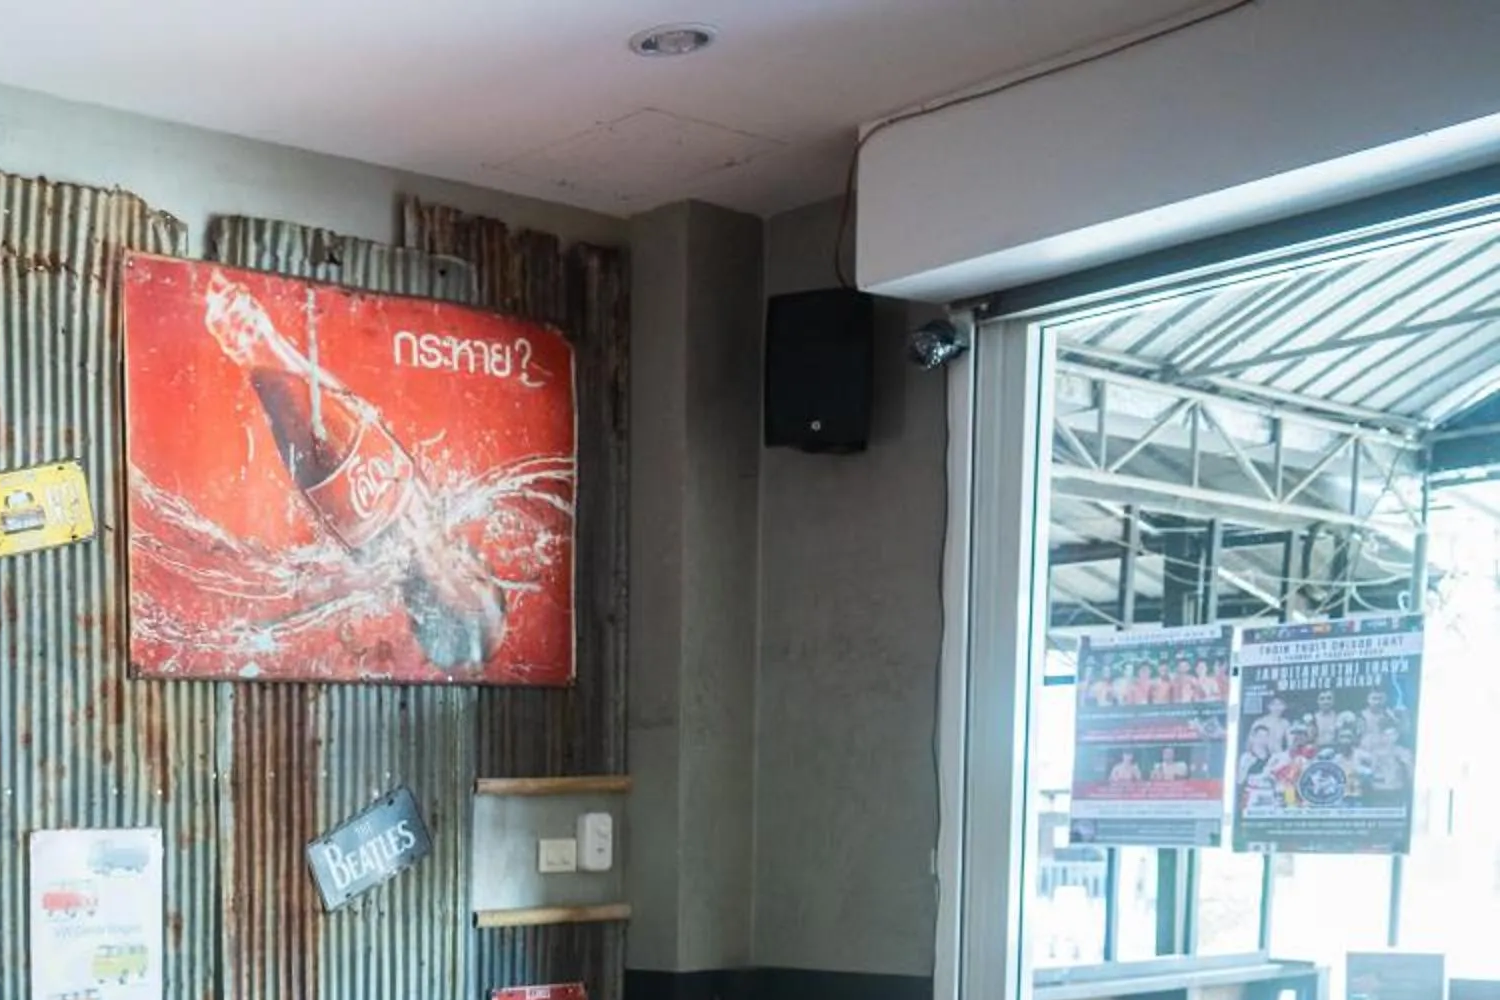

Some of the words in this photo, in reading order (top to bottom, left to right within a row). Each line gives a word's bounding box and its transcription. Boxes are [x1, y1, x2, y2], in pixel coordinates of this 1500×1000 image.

[393, 331, 536, 383] กระหาย?
[323, 820, 416, 890] BEATLES
